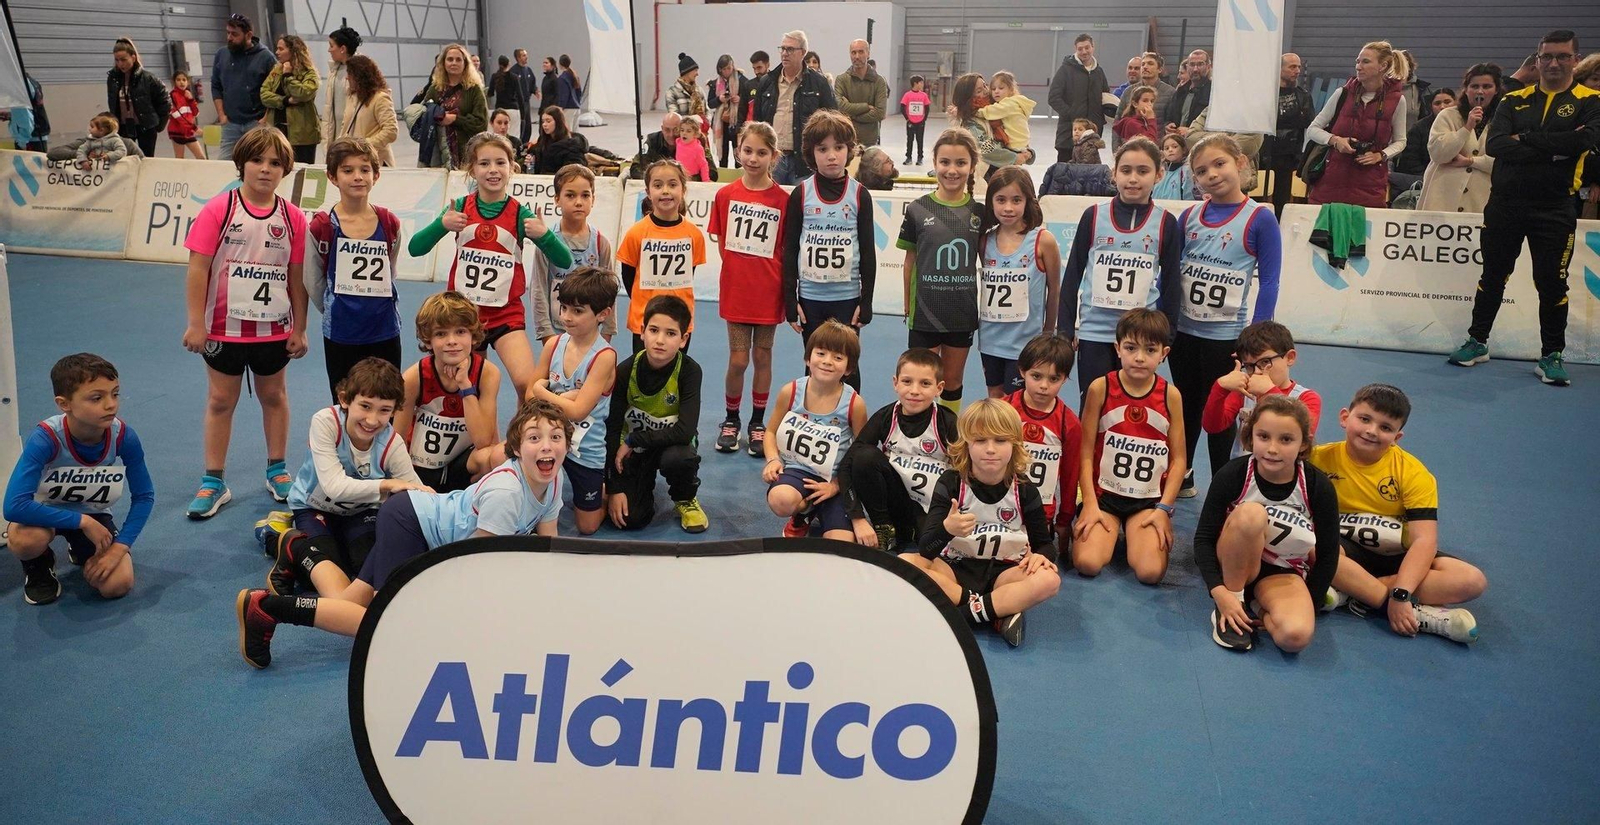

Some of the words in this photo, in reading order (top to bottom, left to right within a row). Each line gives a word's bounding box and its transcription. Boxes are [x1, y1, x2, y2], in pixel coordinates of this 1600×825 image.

[47, 159, 110, 171] DEPOTE
[47, 173, 103, 187] GALEGO
[154, 181, 188, 198] GRUPO
[512, 183, 556, 198] DEPO
[729, 203, 780, 222] Atlántico
[734, 216, 769, 243] 114
[804, 233, 852, 246] Atlántico
[339, 241, 388, 256] Atlántic
[643, 240, 691, 253] Atlántico
[806, 246, 845, 269] 165
[351, 256, 384, 281] 22
[459, 249, 514, 269] Atlántico
[649, 253, 686, 276] 172
[1095, 253, 1152, 269] Atlántico
[232, 266, 286, 281] Atlántico
[465, 264, 498, 292] 92
[922, 275, 950, 283] NASAS
[981, 271, 1027, 283] Atlántico
[1106, 268, 1136, 294] 51
[1183, 264, 1245, 286] Atlántico
[253, 282, 272, 306] 4
[986, 284, 1013, 308] 72
[1189, 280, 1227, 309] 69
[1360, 288, 1385, 296] SERVIZO
[1385, 290, 1421, 299] PROVINCIAL
[1431, 293, 1463, 302] DEPORTES
[417, 412, 467, 432] Atlántic
[626, 409, 674, 430] Atlántic
[785, 416, 840, 443] Atlántico
[424, 430, 459, 456] 87
[785, 429, 831, 466] 163
[1106, 434, 1168, 456] Atlántico
[44, 469, 124, 484] Atlántico
[892, 456, 945, 475] Atlántic
[1030, 462, 1047, 487] 9
[1113, 452, 1156, 483] 88
[47, 485, 111, 504] 164
[911, 472, 928, 496] 2
[1268, 519, 1292, 546] 7
[1340, 525, 1380, 547] 78
[976, 534, 1001, 557] 11
[395, 653, 958, 782] Atlántico
